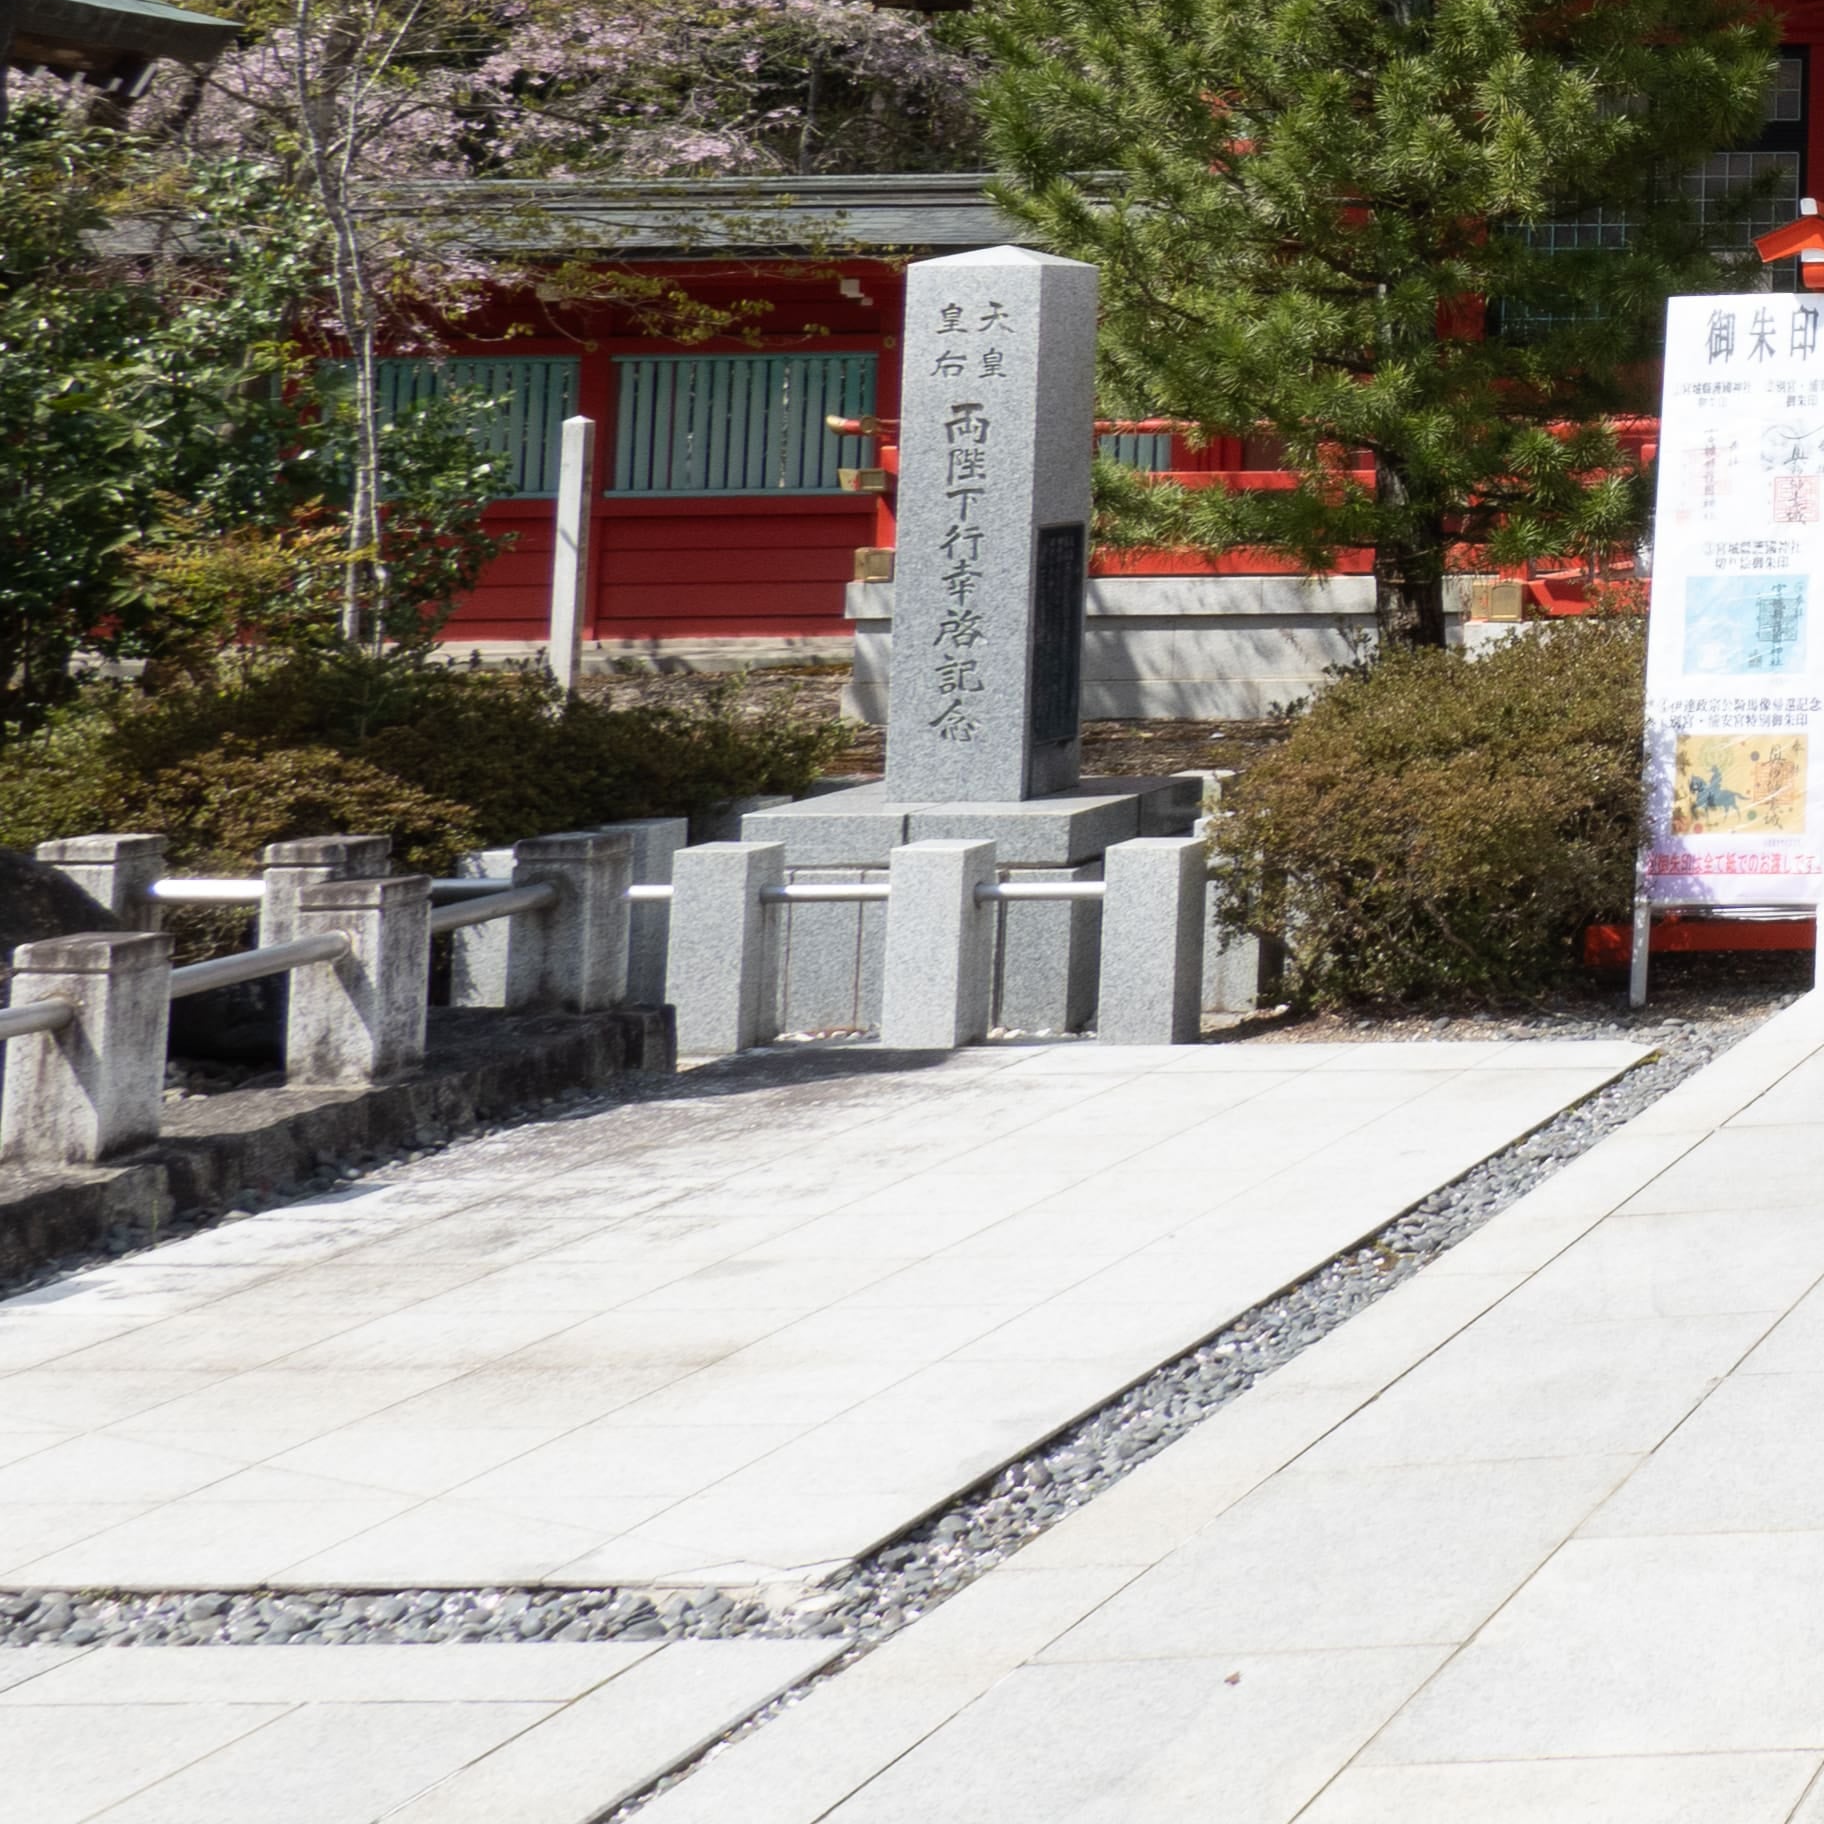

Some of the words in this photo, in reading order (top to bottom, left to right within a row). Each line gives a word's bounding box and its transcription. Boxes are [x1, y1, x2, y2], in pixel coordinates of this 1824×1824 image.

[930, 302, 969, 379] 皇后
[976, 301, 1017, 379] 天皇
[1704, 304, 1820, 365] 御朱印
[929, 402, 991, 744] 両陛下行幸啓記念
